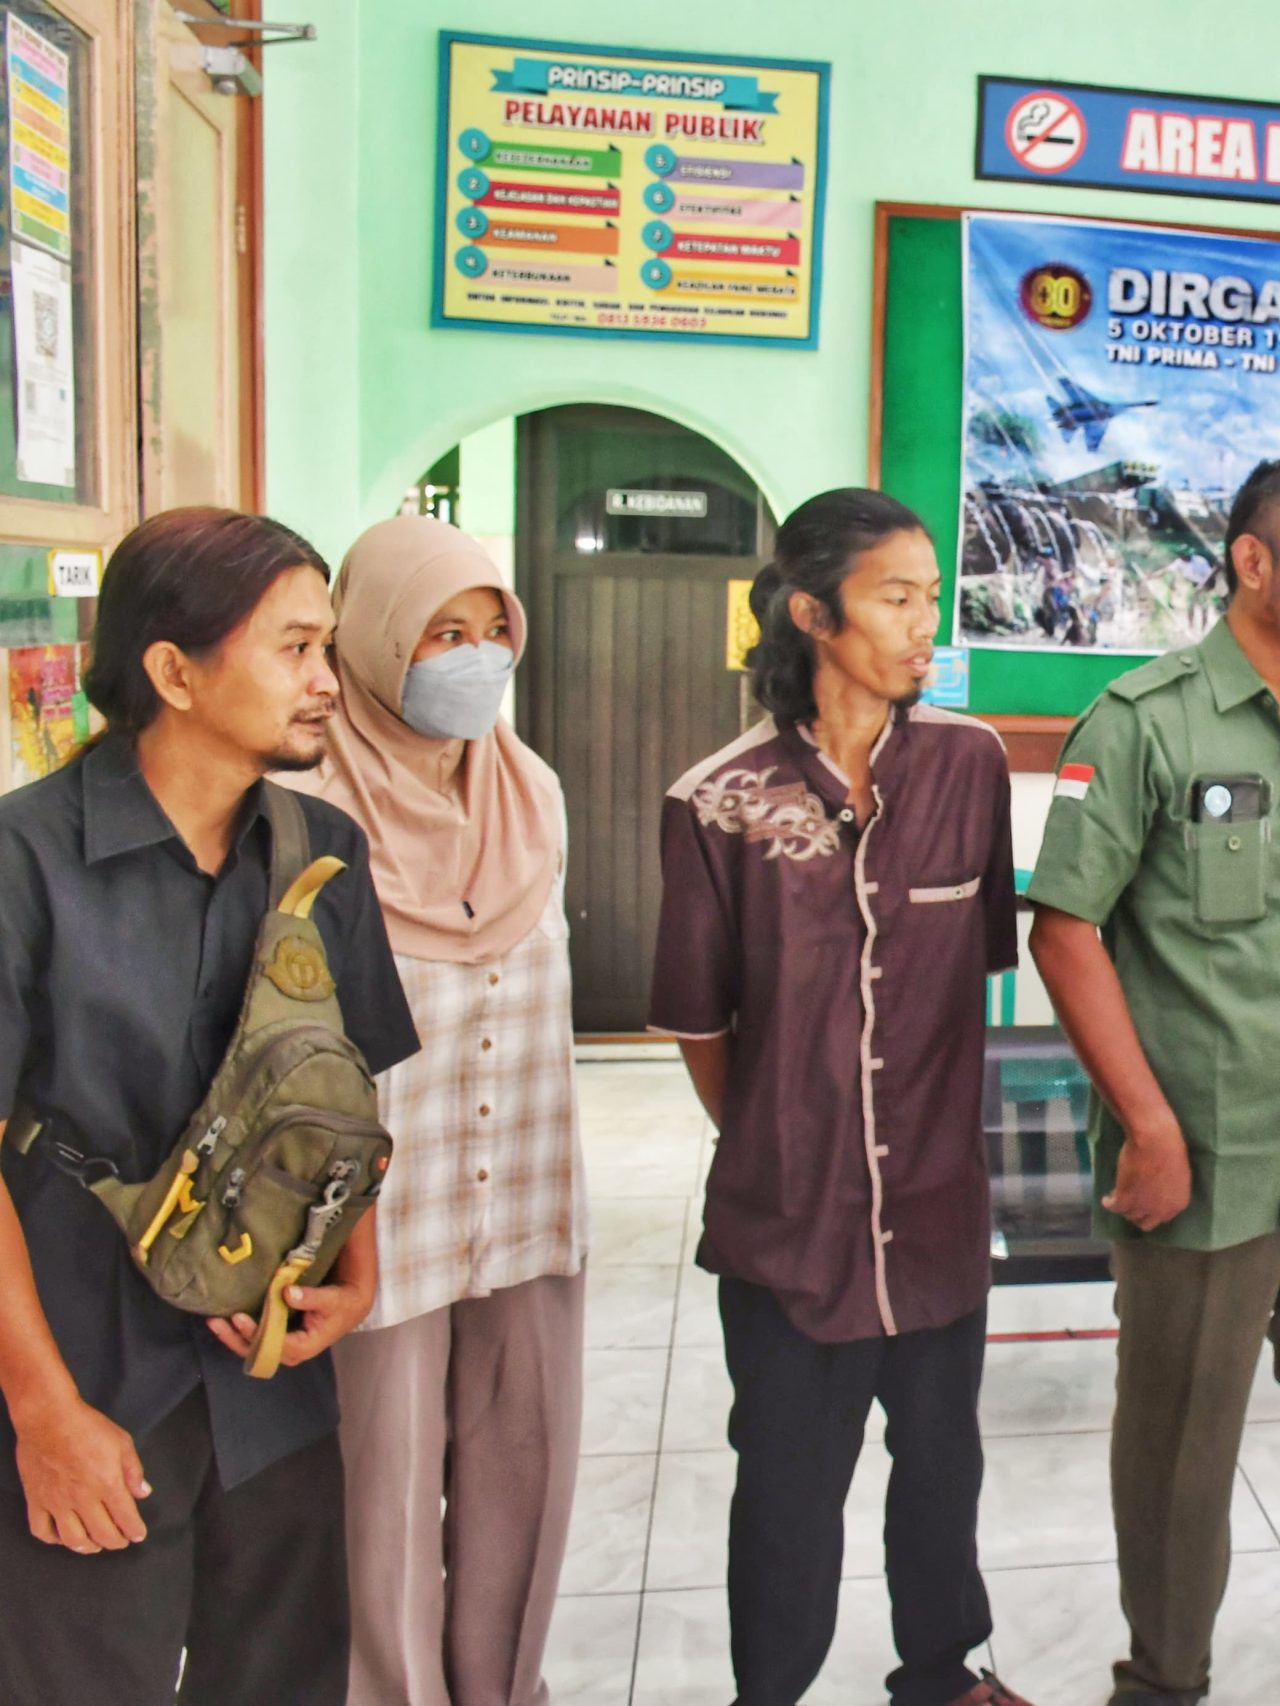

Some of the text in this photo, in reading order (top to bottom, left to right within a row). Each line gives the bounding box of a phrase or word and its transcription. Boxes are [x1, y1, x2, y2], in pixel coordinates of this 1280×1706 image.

[548, 66, 725, 98] PRINSIP-PRINSIP
[504, 99, 763, 142] PELAYANAN PUBLIK
[1121, 108, 1257, 181] AREA
[1108, 318, 1122, 339] 5
[1132, 321, 1254, 348] OKTOBER
[1105, 343, 1141, 364] TNI
[1148, 346, 1218, 370] PRIMA
[1241, 352, 1276, 373] TNI
[58, 566, 92, 586] TARIK
